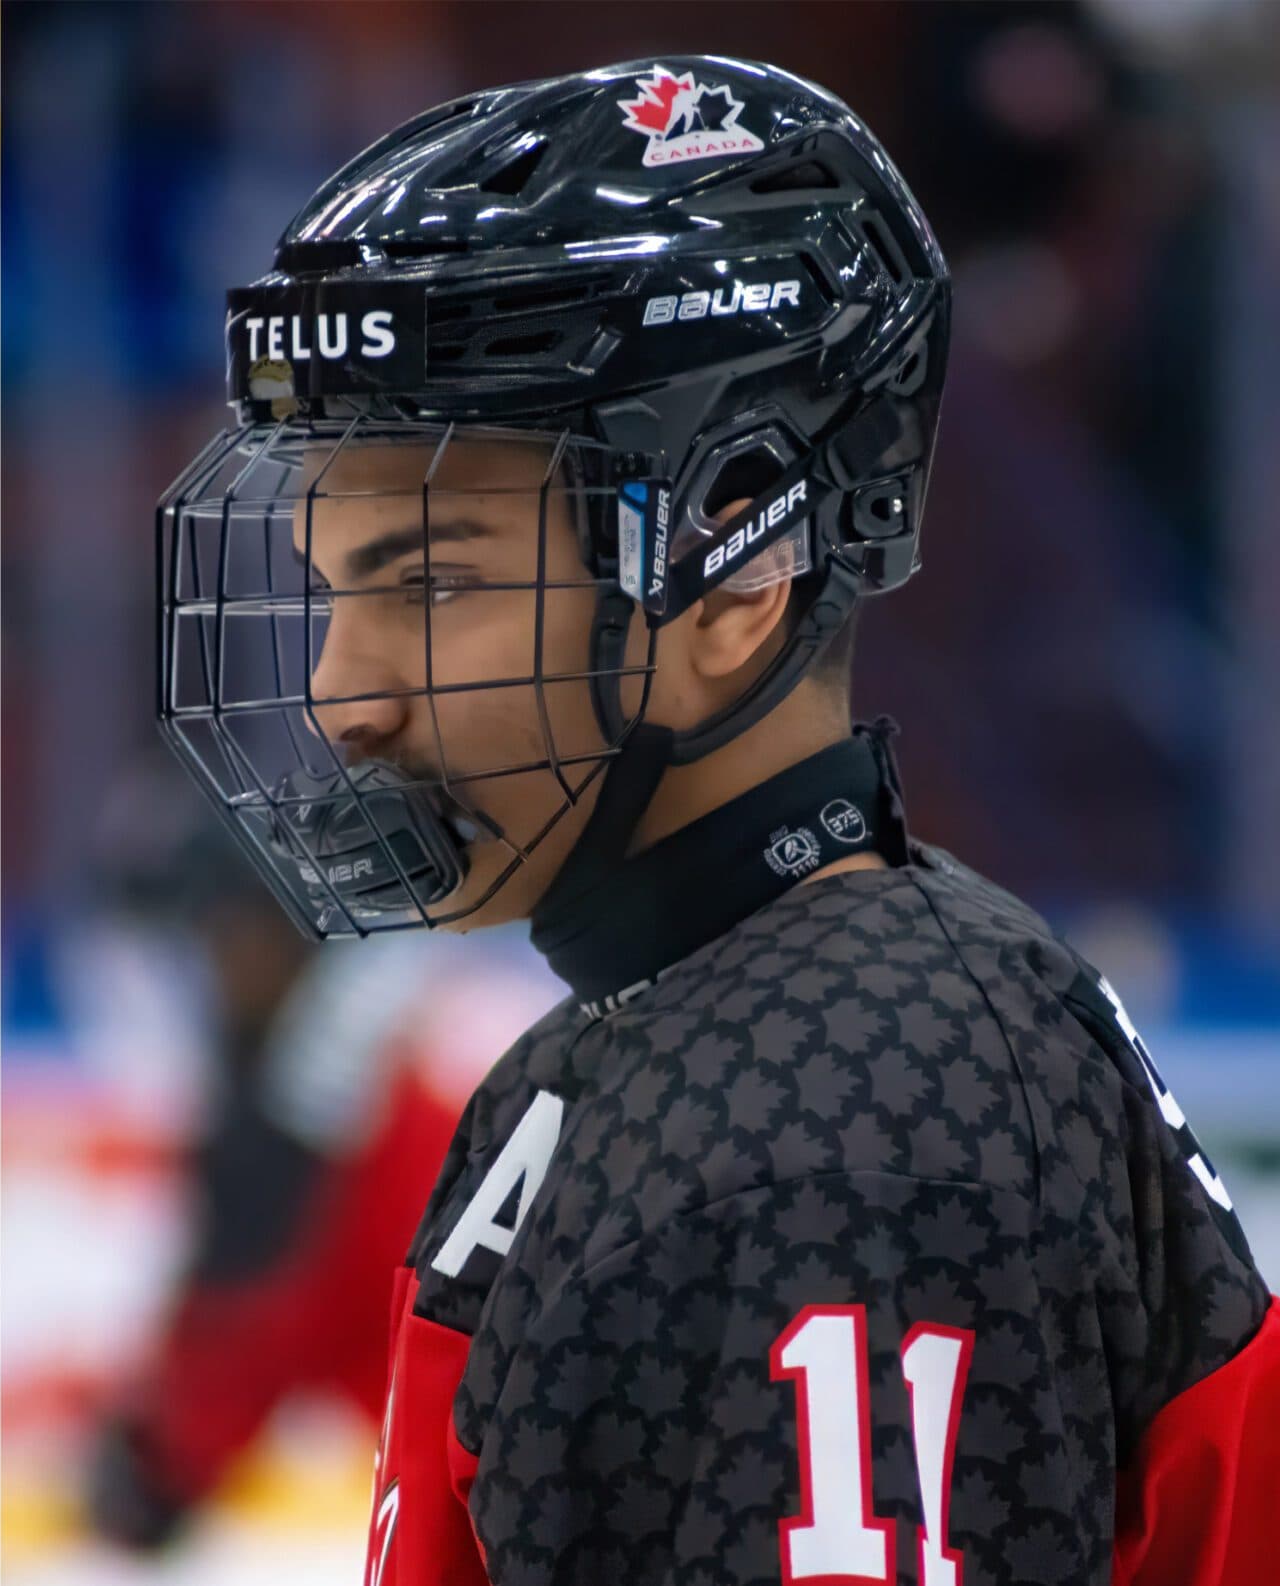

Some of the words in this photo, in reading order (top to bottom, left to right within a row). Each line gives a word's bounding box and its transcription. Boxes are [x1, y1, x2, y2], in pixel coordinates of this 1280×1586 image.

[650, 137, 755, 163] CANADA
[245, 310, 396, 361] TELUS
[642, 279, 801, 326] BAUER
[653, 488, 671, 578] BAUER
[703, 479, 808, 578] BAUER
[431, 1089, 564, 1278] A
[769, 1303, 976, 1586] 11
